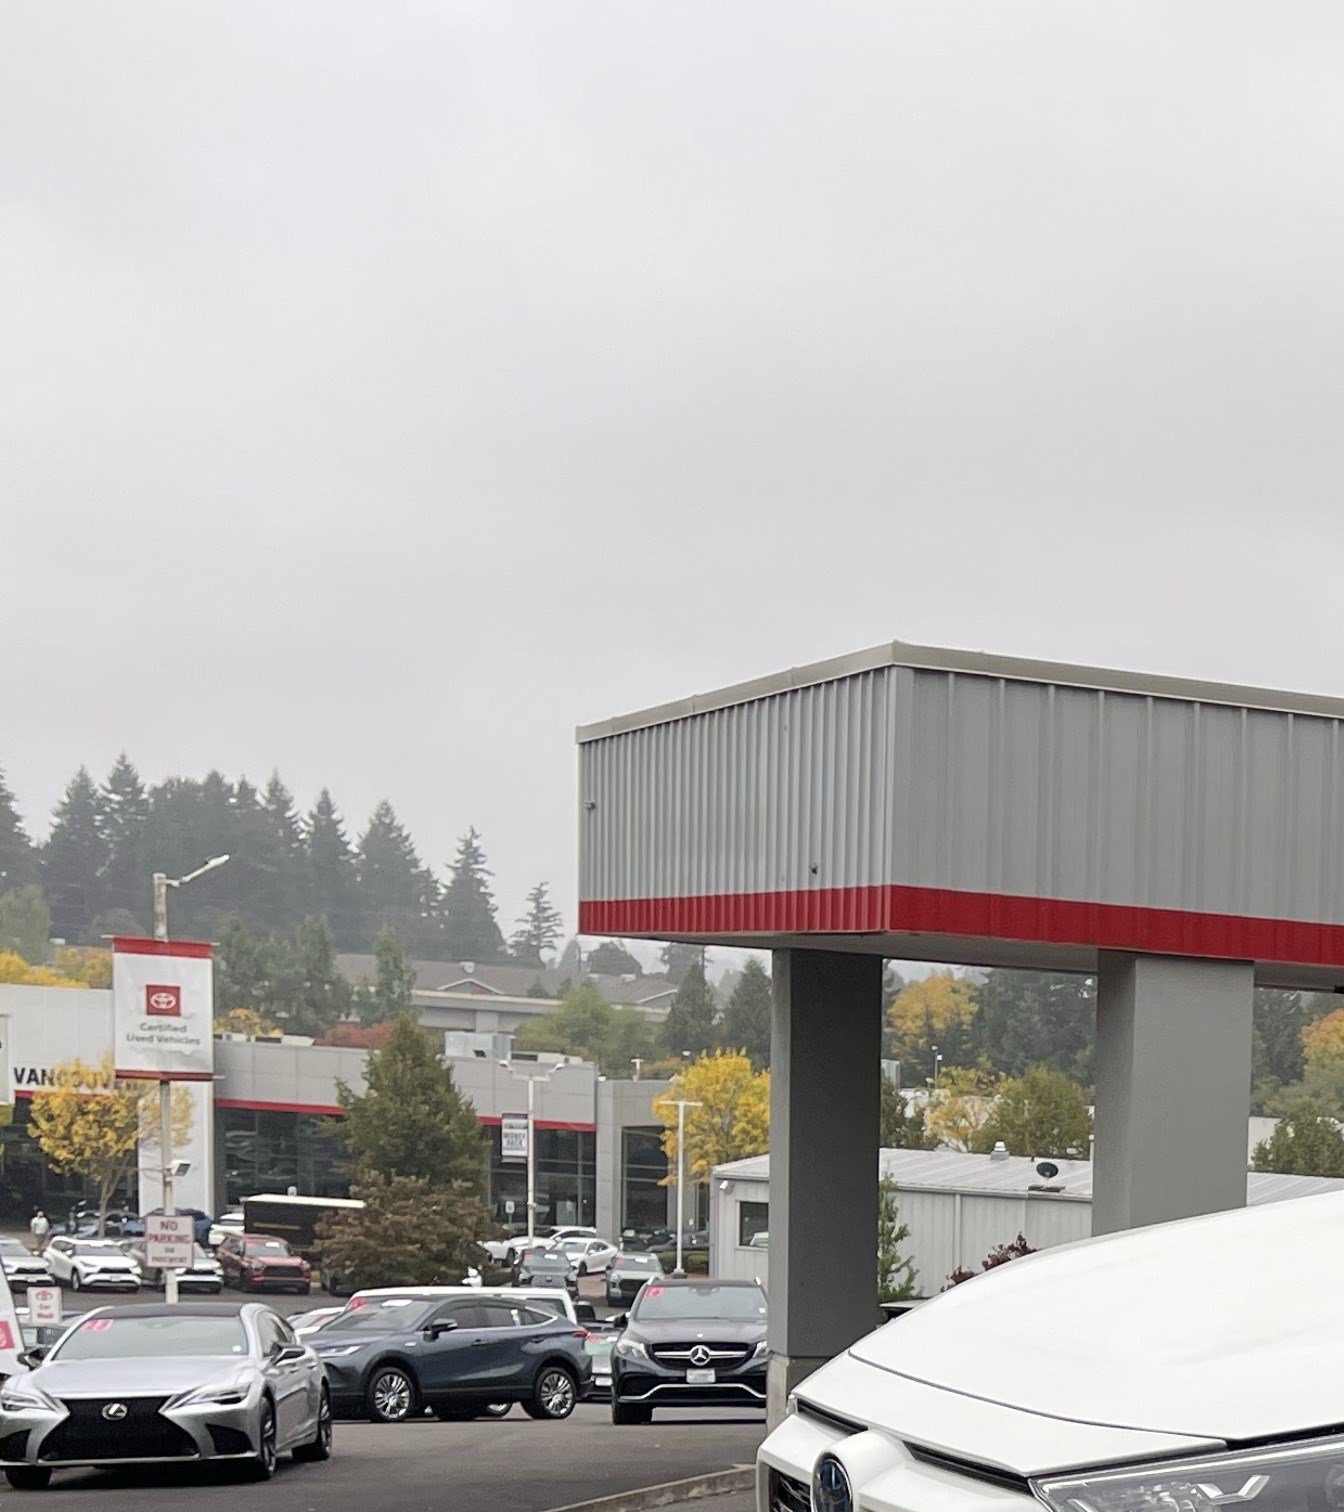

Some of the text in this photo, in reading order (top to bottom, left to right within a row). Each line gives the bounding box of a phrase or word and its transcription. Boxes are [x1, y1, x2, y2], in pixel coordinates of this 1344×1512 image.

[140, 1023, 187, 1033] Certified
[126, 1034, 200, 1045] Used Vehicles
[160, 1220, 178, 1231] NO
